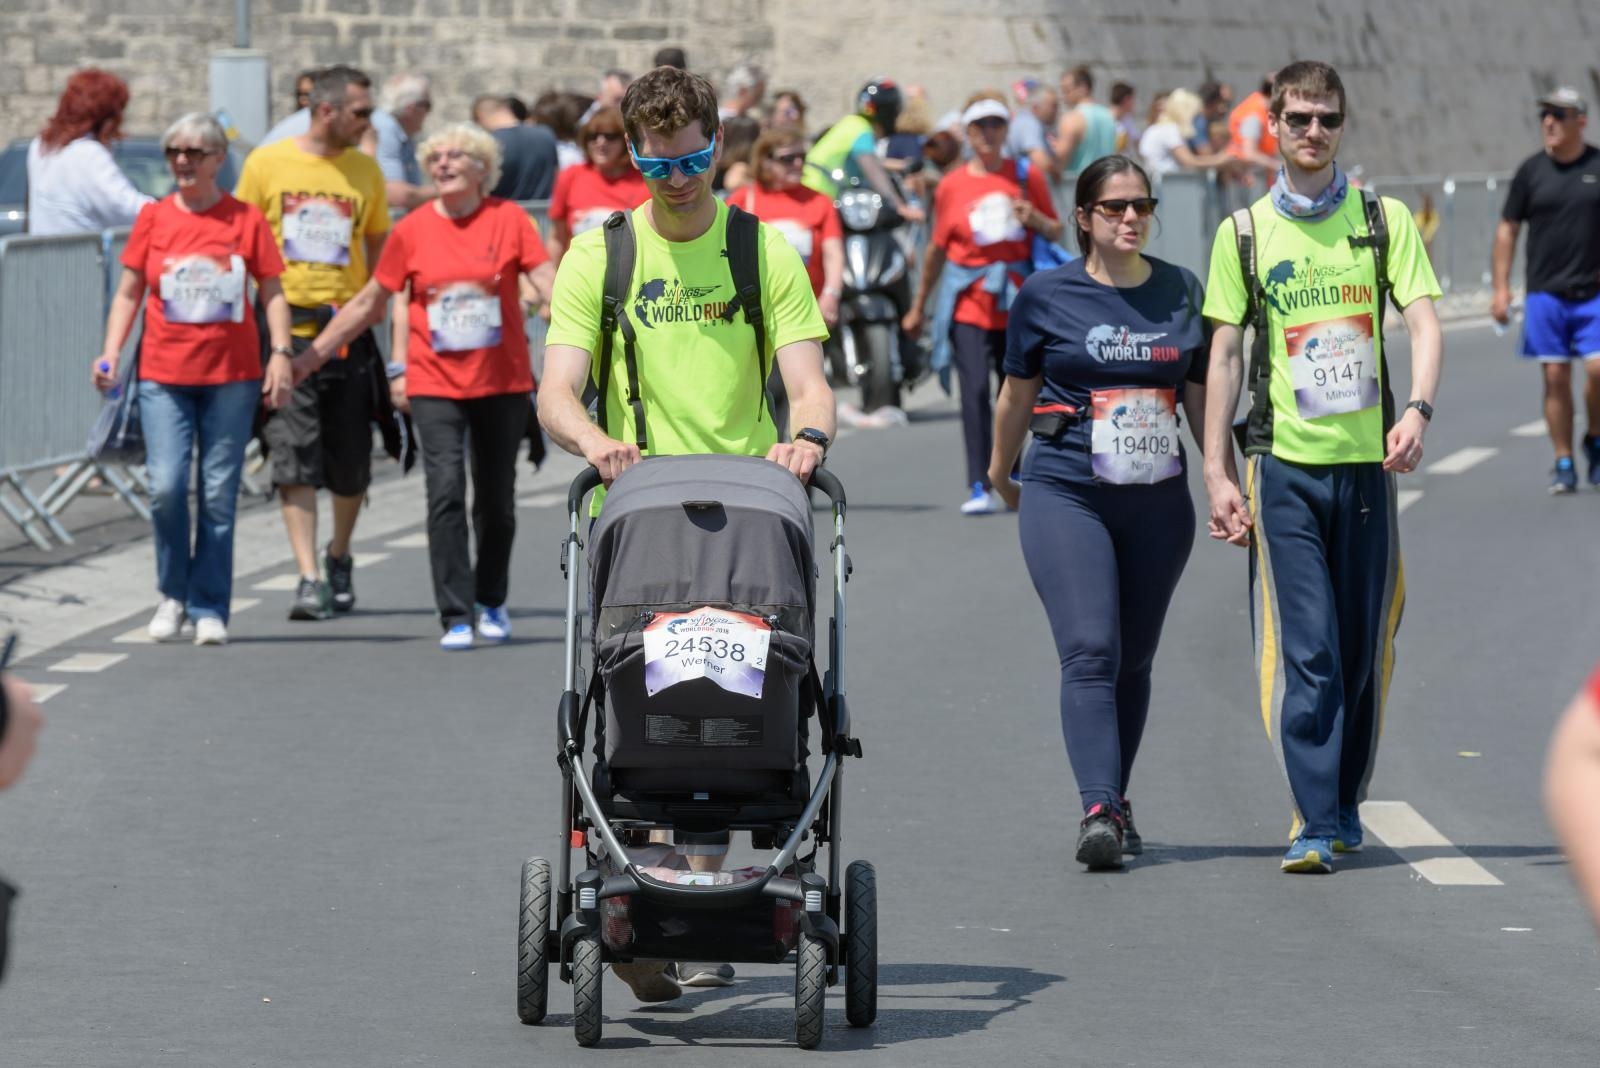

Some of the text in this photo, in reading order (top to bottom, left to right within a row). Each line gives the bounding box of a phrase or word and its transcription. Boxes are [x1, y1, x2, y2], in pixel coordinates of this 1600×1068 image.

[1296, 267, 1336, 280] WINGS
[1304, 276, 1326, 288] LIFE
[665, 287, 701, 298] WINGS
[669, 297, 690, 305] LIFE
[1283, 284, 1373, 311] WORLD RUN
[652, 304, 702, 322] WORLD
[1101, 345, 1180, 362] WORLD RUN
[1313, 361, 1363, 387] 9147
[1112, 435, 1170, 455] 19409
[665, 636, 746, 662] 24538
[681, 657, 726, 676] Werner
[756, 657, 763, 666] 2
